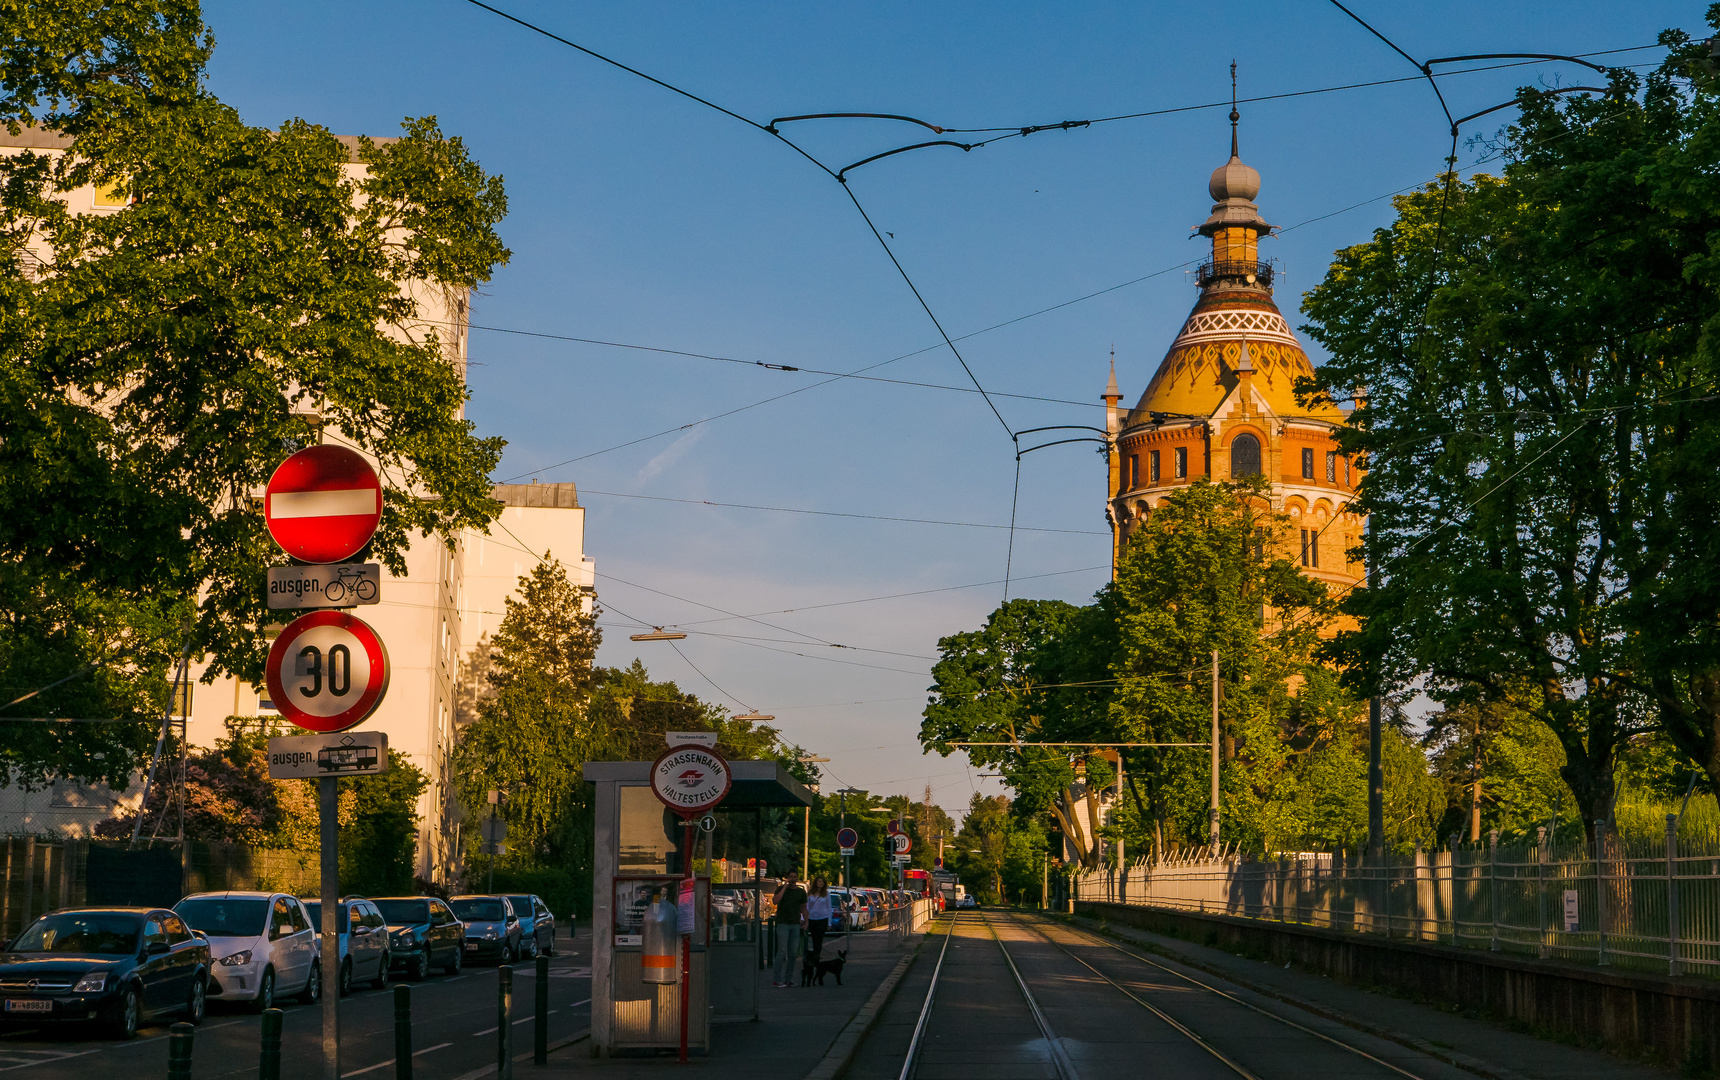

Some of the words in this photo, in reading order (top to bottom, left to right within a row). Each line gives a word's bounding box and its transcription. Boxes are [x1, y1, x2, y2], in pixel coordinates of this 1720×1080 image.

[271, 579, 323, 597] ausgen.
[299, 644, 350, 698] 30
[272, 751, 316, 767] ausgen.
[660, 753, 723, 776] STRASSENBAHN
[662, 784, 719, 804] HALTESTELLE
